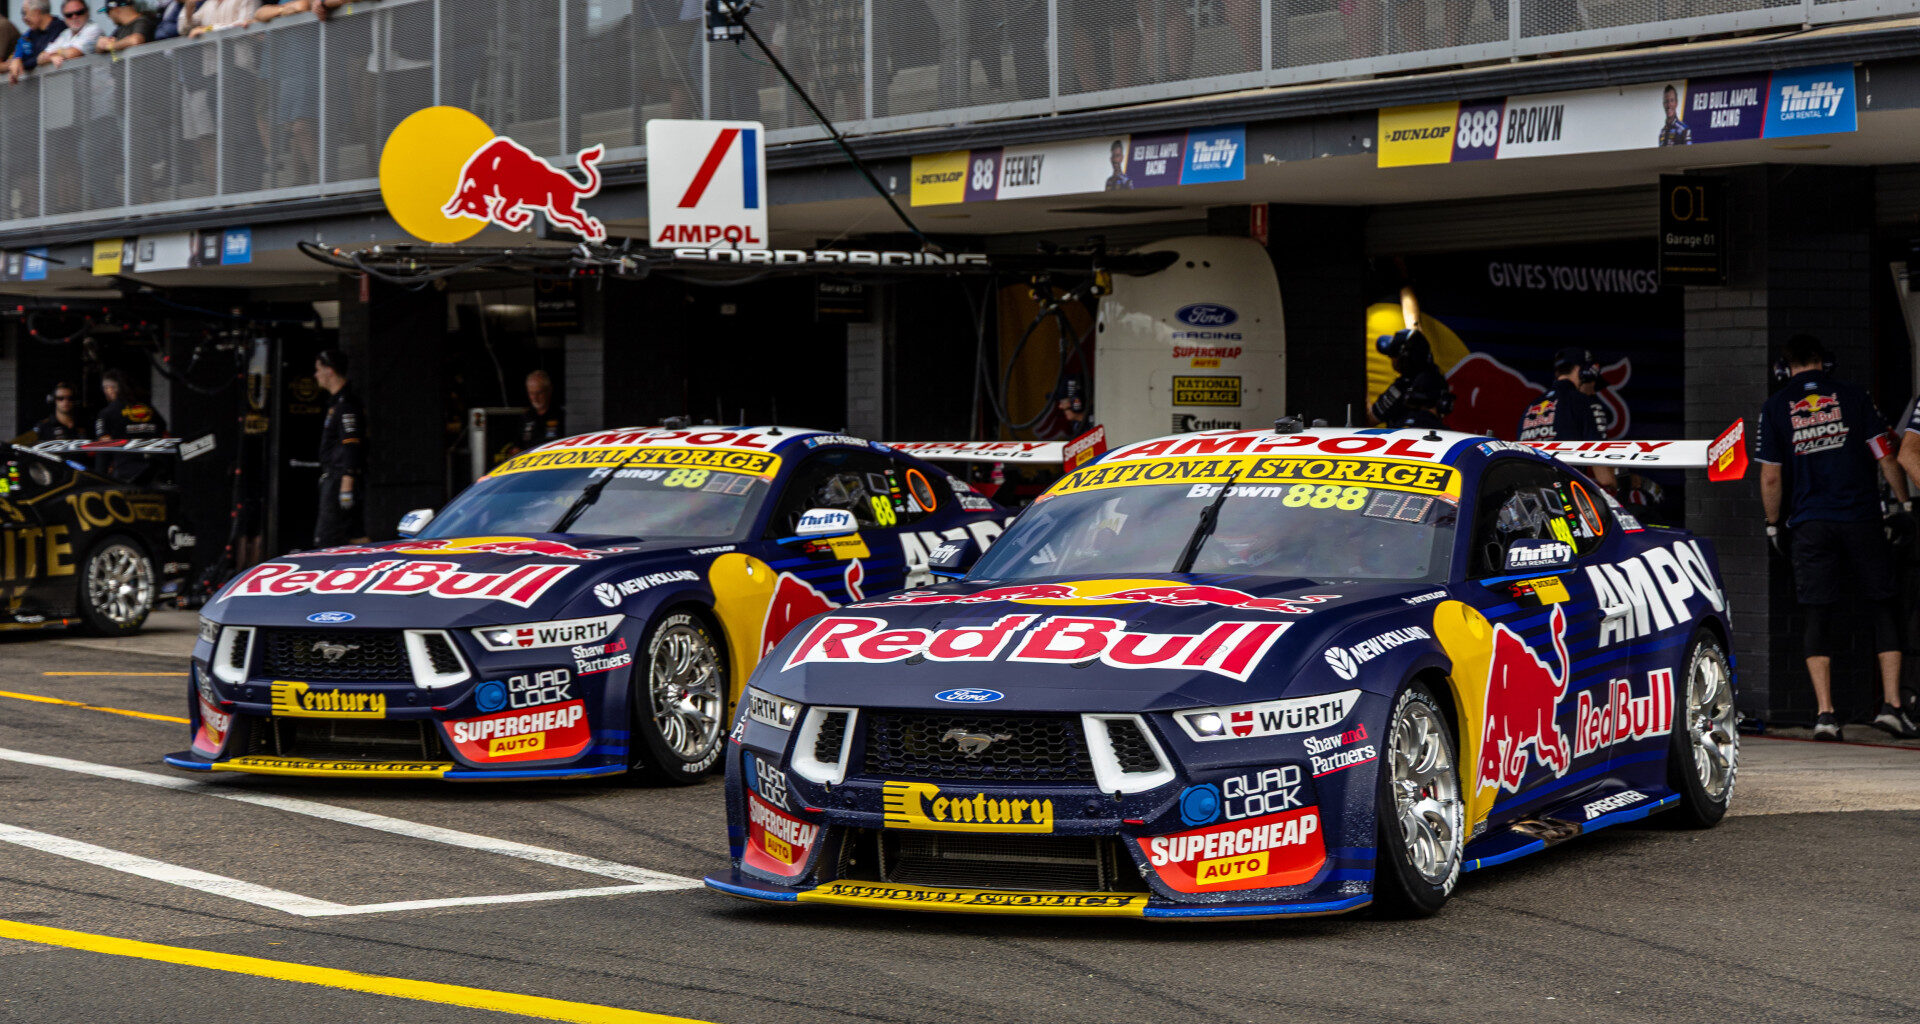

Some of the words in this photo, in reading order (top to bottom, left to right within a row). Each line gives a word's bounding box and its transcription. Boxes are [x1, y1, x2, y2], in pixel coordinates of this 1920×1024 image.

[1693, 92, 1708, 111] RED
[1709, 91, 1728, 109] BULL
[1729, 88, 1758, 107] AMPOL
[1780, 82, 1845, 117] Thrifty
[1506, 105, 1565, 144] BROWN
[1710, 109, 1741, 128] RACING
[1781, 112, 1795, 121] CAR
[1796, 110, 1822, 120] RENTAL
[1390, 127, 1451, 142] DUNLOP
[1457, 109, 1499, 149] 888
[1192, 139, 1238, 168] Thrifty
[920, 171, 963, 185] DUNLOP
[972, 159, 994, 191] 88
[1003, 154, 1045, 187] FEENEY
[1671, 185, 1709, 222] 01
[657, 225, 760, 244] AMPOL
[1666, 233, 1702, 248] Garage
[1703, 233, 1715, 246] 01
[1488, 262, 1547, 289] GIVES
[1547, 265, 1589, 292] YOU
[1590, 268, 1659, 294] WINGS
[1187, 306, 1227, 323] Ford
[1172, 332, 1242, 340] RACING
[1172, 345, 1242, 359] SUPERCHEAP
[1177, 379, 1237, 389] NATIONAL
[1179, 391, 1236, 401] STORAGE
[1172, 413, 1242, 432] Century
[1791, 411, 1816, 429] Red
[1815, 407, 1842, 426] Bull
[541, 431, 768, 450] AMPOL
[1064, 427, 1104, 462] SUPERCHEAP
[1709, 421, 1744, 465] SUPERCHEAP
[1792, 422, 1849, 444] AMPOL
[1794, 434, 1847, 453] RACING
[499, 448, 629, 473] NATIONAL
[631, 448, 772, 472] STORAGE
[963, 449, 1033, 459] Fuels
[1111, 436, 1446, 460] AMPOL
[1552, 451, 1662, 462] Fuels
[663, 468, 710, 488] 88
[1061, 458, 1246, 491] NATIONAL
[1254, 457, 1445, 490] STORAGE
[1186, 483, 1282, 499] Brown
[1282, 483, 1369, 511] 888
[66, 490, 135, 532] 100
[799, 513, 850, 526] Thrifty
[871, 495, 897, 526] 88
[1508, 542, 1572, 563] Thrifty
[1527, 558, 1557, 566] RENTAL
[215, 559, 406, 604] Red
[363, 560, 581, 609] Bull
[619, 577, 649, 598] NEW
[646, 569, 700, 592] HOLLAND
[1585, 539, 1725, 648] AMPOL
[1410, 590, 1448, 604] DUNLOP
[538, 620, 609, 644] WÜRTH
[571, 644, 606, 662] Shaw
[604, 637, 628, 654] and
[780, 613, 1042, 673] Red
[1006, 615, 1295, 683] Bull
[1349, 640, 1380, 665] NEW
[1377, 625, 1432, 650] HOLLAND
[575, 652, 632, 674] Partners
[508, 668, 571, 694] QUAD
[271, 680, 387, 719] Century
[510, 683, 573, 709] LOCK
[453, 703, 584, 744] SUPERCHEAP
[1259, 699, 1344, 731] WÜRTH
[1574, 676, 1615, 759] Red
[1611, 667, 1675, 745] Bull
[494, 736, 539, 753] AUTO
[1303, 734, 1343, 756] Shaw
[1341, 722, 1369, 744] and
[1310, 743, 1377, 776] Partners
[1223, 764, 1301, 799] QUAD
[883, 780, 1054, 833] Century
[1224, 785, 1303, 820] LOCK
[1583, 789, 1650, 820] FREIGHTER
[766, 837, 790, 860] AUTO
[1150, 814, 1319, 868] SUPERCHEAP
[1203, 857, 1261, 880] AUTO
[831, 884, 967, 904] NATIONAL
[976, 892, 1132, 908] STORAGE
